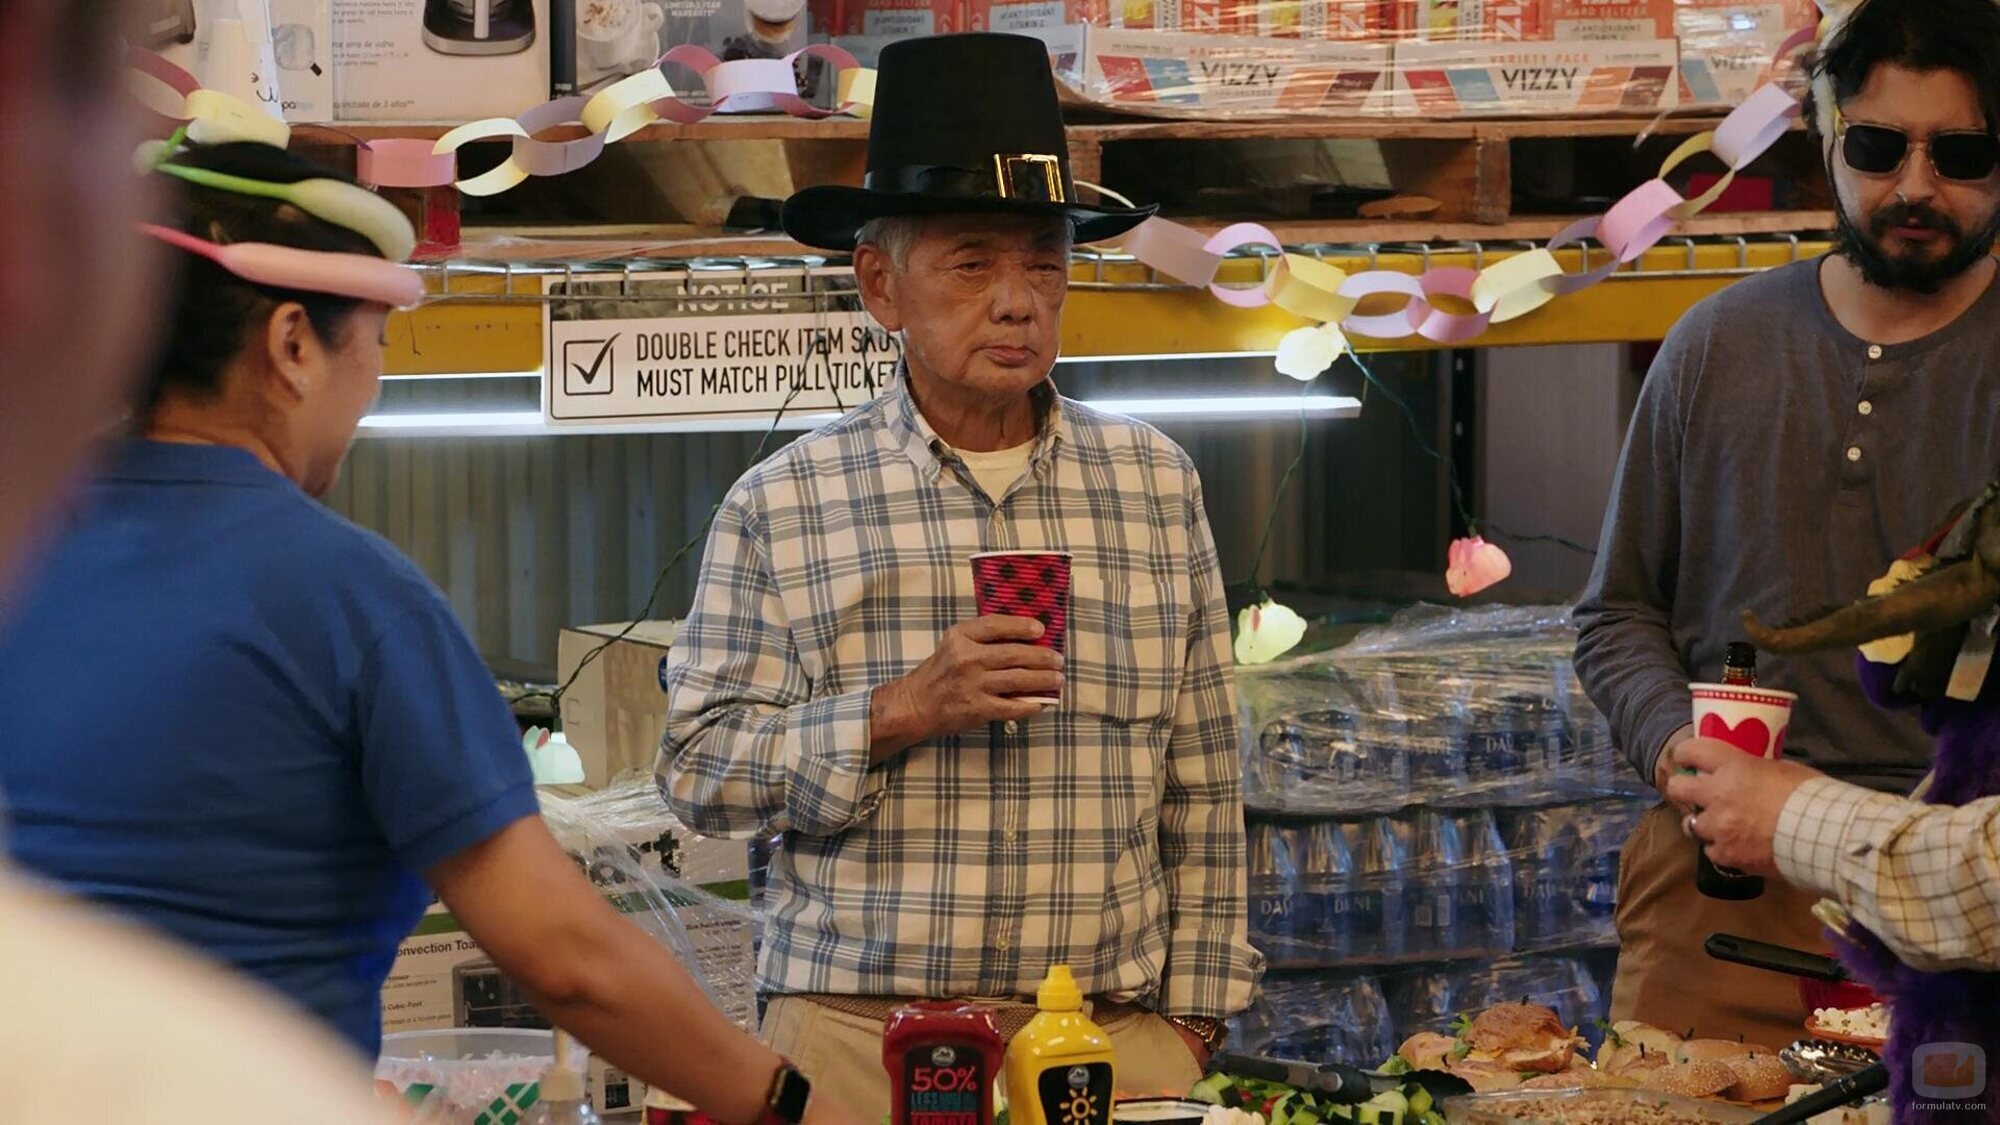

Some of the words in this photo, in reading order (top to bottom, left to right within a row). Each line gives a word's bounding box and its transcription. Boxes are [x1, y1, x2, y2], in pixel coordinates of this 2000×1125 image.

[1489, 53, 1546, 64] VARIETY
[1200, 61, 1281, 87] VIZZY
[1501, 67, 1578, 92] VIZZY
[677, 282, 789, 312] NOTICE
[636, 331, 717, 361] DOUBLE
[724, 328, 790, 358] CHECK
[798, 327, 843, 356] ITEM
[636, 368, 694, 397] MUST
[701, 365, 767, 396] MATCH
[776, 363, 825, 392] PULL
[397, 942, 452, 957] onvection
[911, 1065, 977, 1092] 50%
